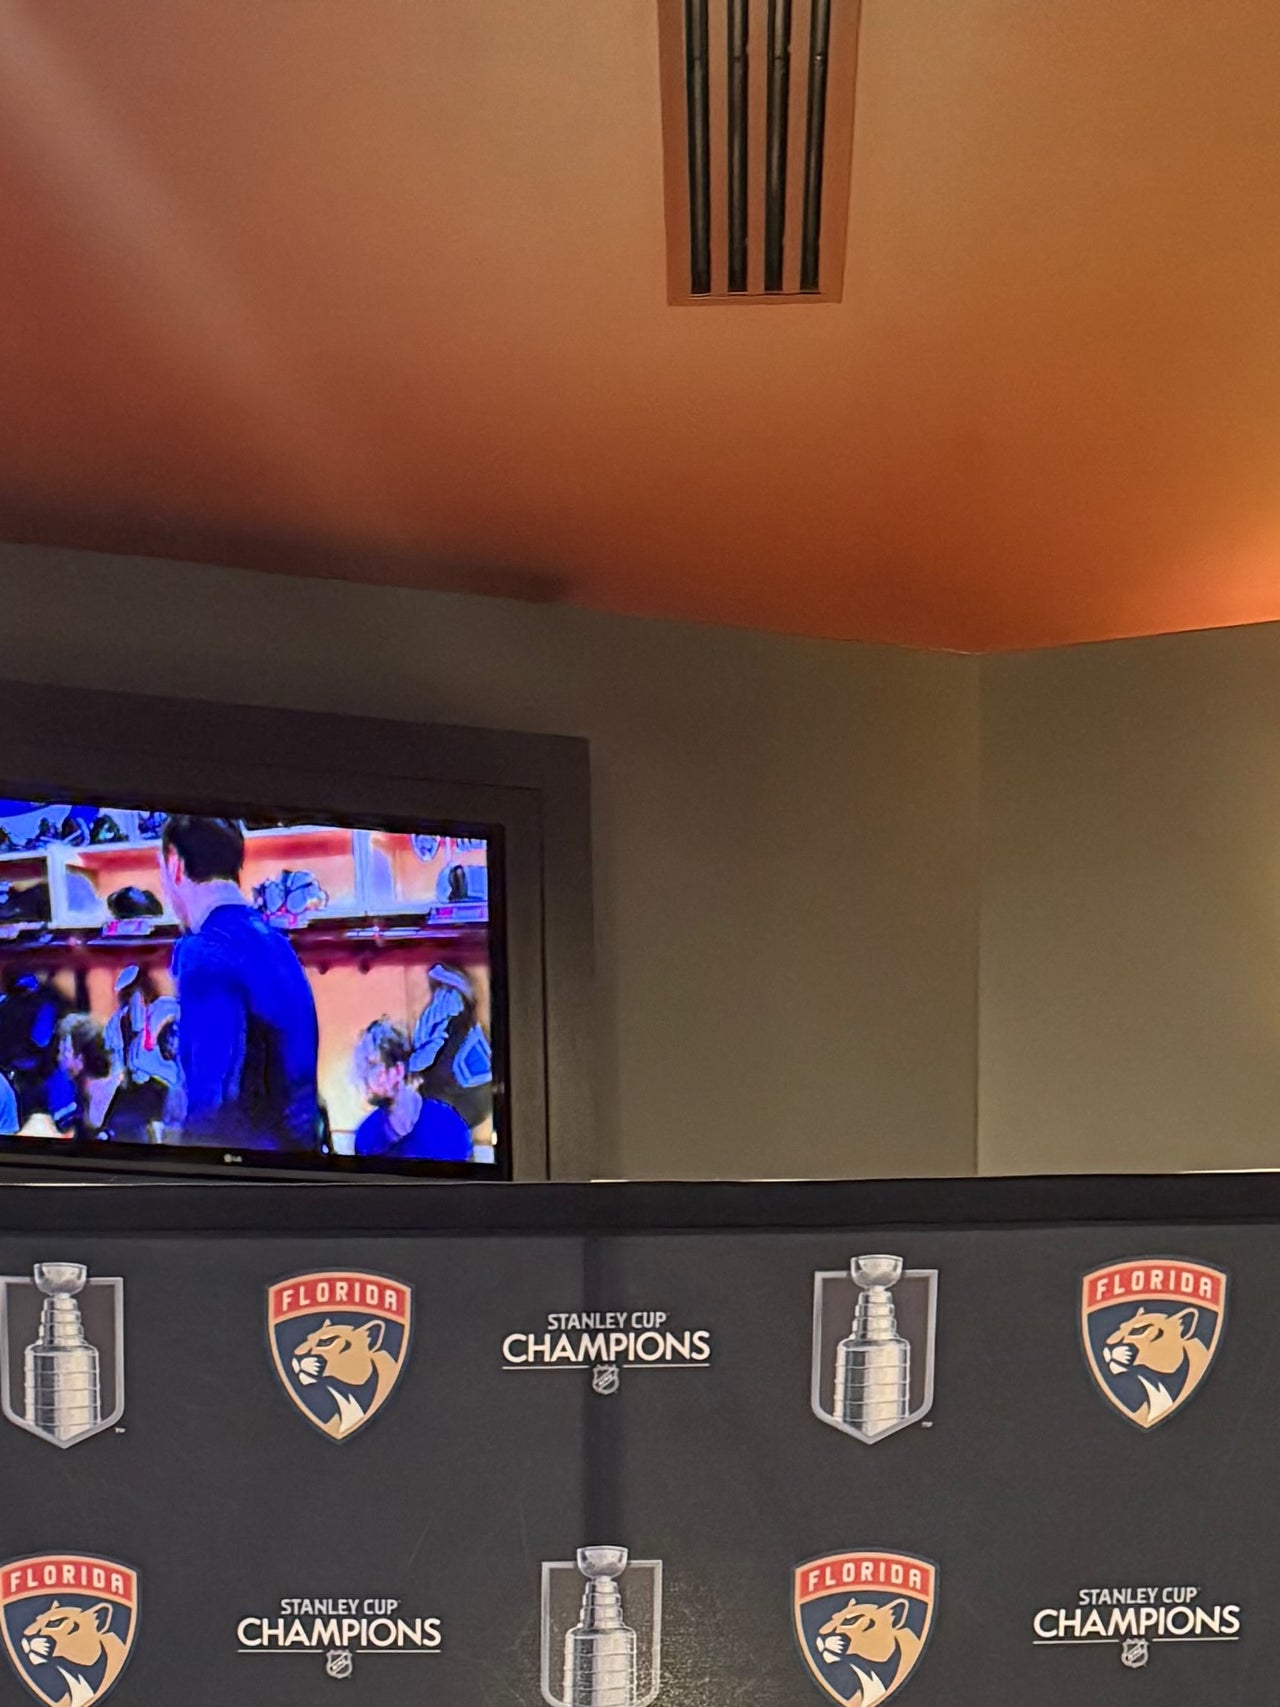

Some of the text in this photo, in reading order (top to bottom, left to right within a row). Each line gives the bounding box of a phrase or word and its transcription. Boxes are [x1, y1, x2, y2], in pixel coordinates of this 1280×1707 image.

[283, 1282, 396, 1310] FLORIDA
[1097, 1270, 1211, 1299] FLORIDA
[548, 1312, 666, 1330] STANLEY CUP
[503, 1331, 710, 1362] CHAMPIONS
[11, 1565, 123, 1594] FLORIDA
[809, 1562, 921, 1591] FLORIDA
[281, 1599, 398, 1614] STANLEY CUP
[1079, 1587, 1197, 1605] STANLEY CUP
[238, 1618, 441, 1646] CHAMPIONS
[1034, 1605, 1240, 1638] CHAMPIONS
